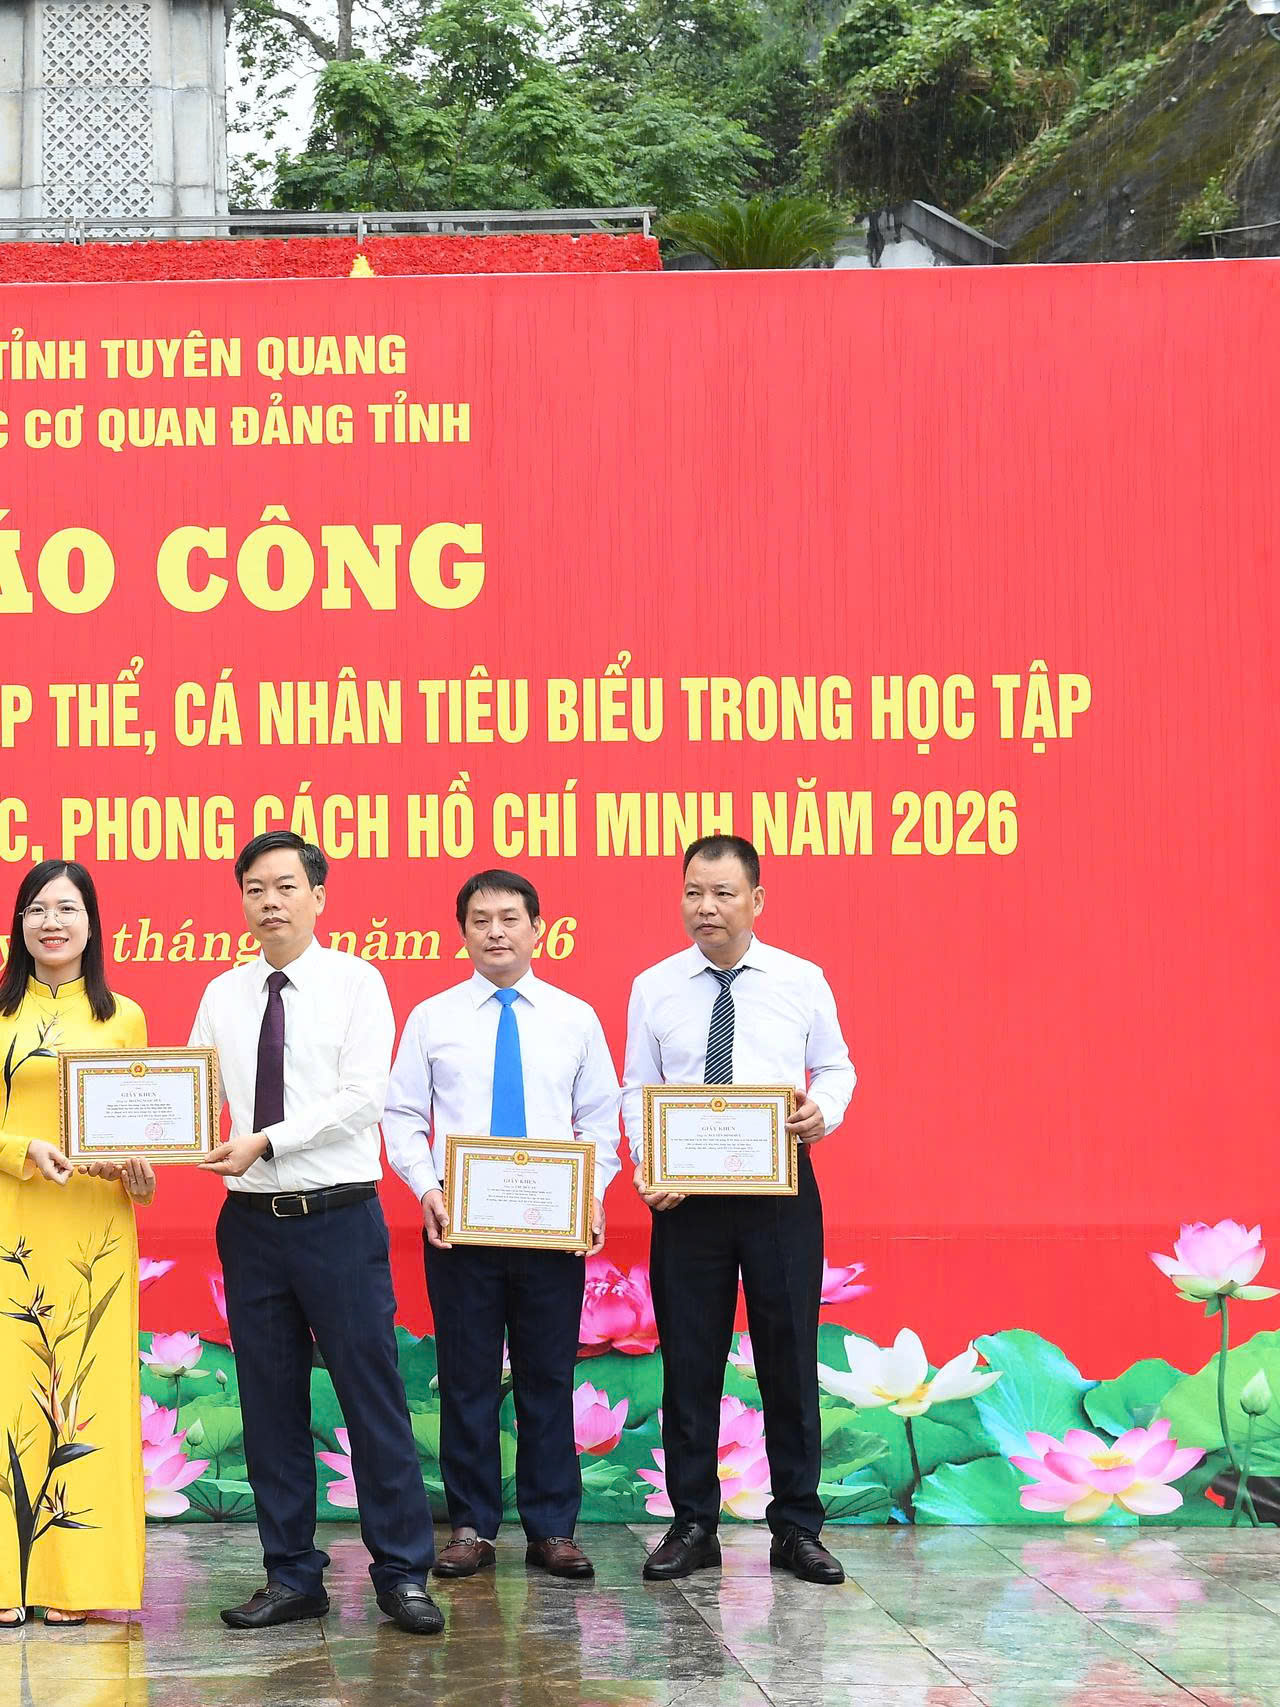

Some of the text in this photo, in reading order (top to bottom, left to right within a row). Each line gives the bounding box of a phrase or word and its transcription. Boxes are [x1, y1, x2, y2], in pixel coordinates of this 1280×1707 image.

[101, 330, 241, 378] TUYÊN
[258, 334, 406, 380] QUANG
[24, 404, 84, 449] CƠ
[98, 407, 216, 452] QUAN
[230, 392, 353, 445] ĐẢNG
[368, 390, 470, 443] TỈNH
[157, 505, 485, 612] CÔNG
[49, 656, 156, 755] THỂ,
[175, 668, 242, 747] CÁ
[259, 667, 402, 745] NHÂN
[419, 665, 528, 743] TIÊU
[548, 650, 663, 742] BIỂU
[681, 675, 852, 741] TRONG
[872, 674, 974, 754] HỌC
[992, 660, 1091, 753] TẬP
[62, 796, 234, 860] PHONG
[253, 781, 389, 858] CÁCH
[408, 771, 474, 858] HỒ
[493, 779, 578, 858] CHÍ
[596, 792, 733, 856] MINH
[752, 777, 872, 855] NĂM
[892, 790, 1018, 856] 2026
[113, 918, 261, 968] tháng
[329, 917, 440, 960] năm
